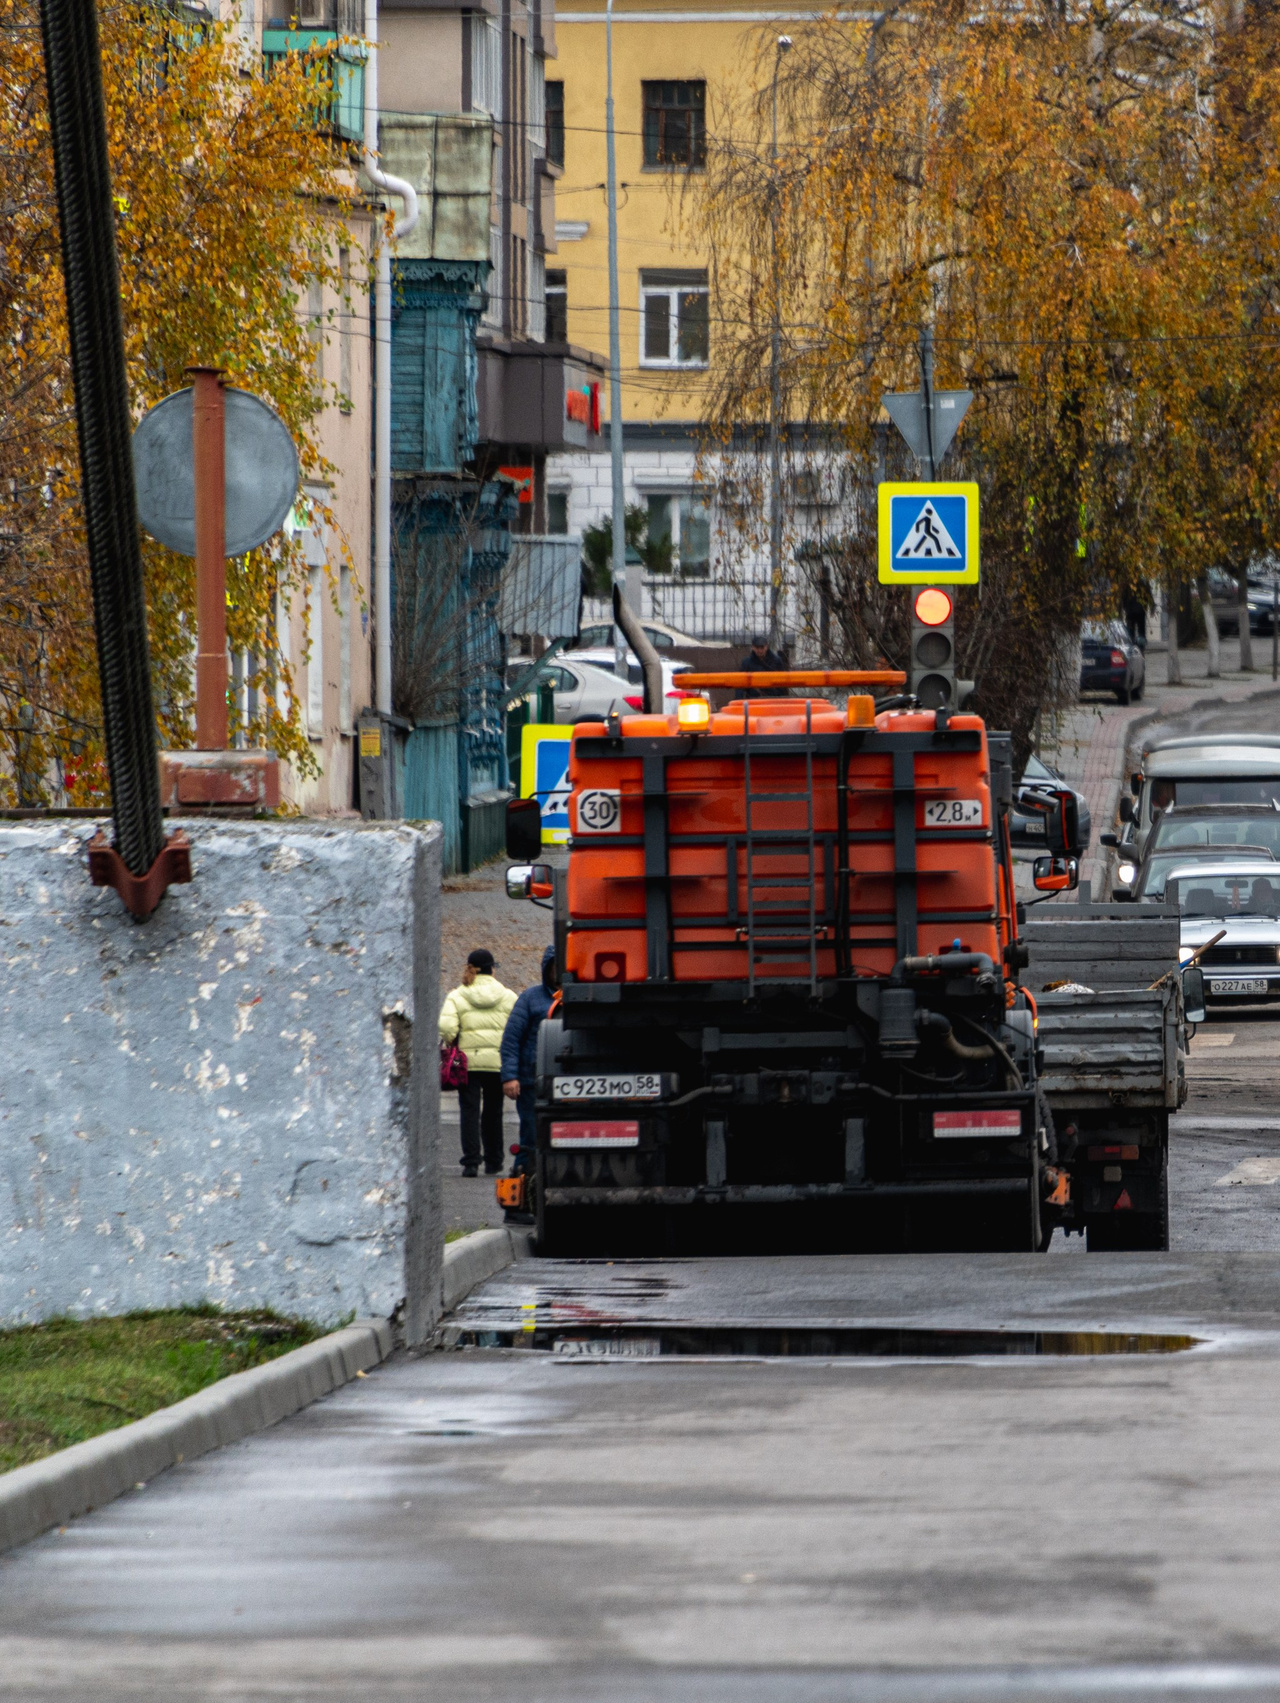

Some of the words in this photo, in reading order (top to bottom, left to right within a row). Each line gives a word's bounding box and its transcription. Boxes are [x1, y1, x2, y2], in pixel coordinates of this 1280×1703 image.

[588, 801, 610, 820] 30
[935, 801, 963, 823] 2,8
[637, 1076, 654, 1089] 58
